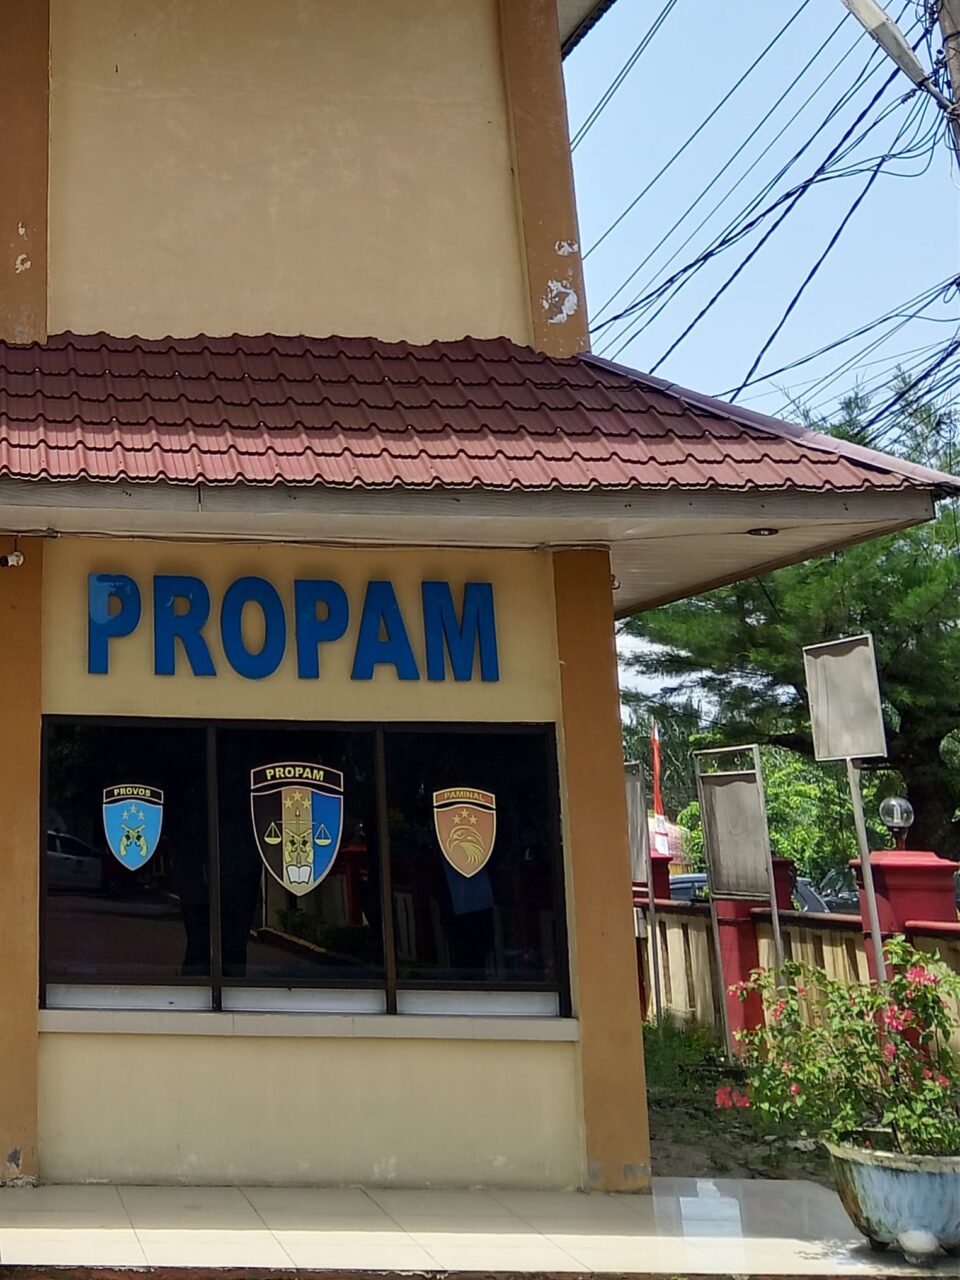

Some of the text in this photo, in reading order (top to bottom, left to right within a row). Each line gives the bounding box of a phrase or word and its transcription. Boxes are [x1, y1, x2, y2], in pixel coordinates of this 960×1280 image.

[87, 572, 500, 682] PROPAM
[265, 767, 324, 781] PROPAM
[113, 787, 151, 797] PROVOS
[444, 791, 484, 801] PAMINAL
